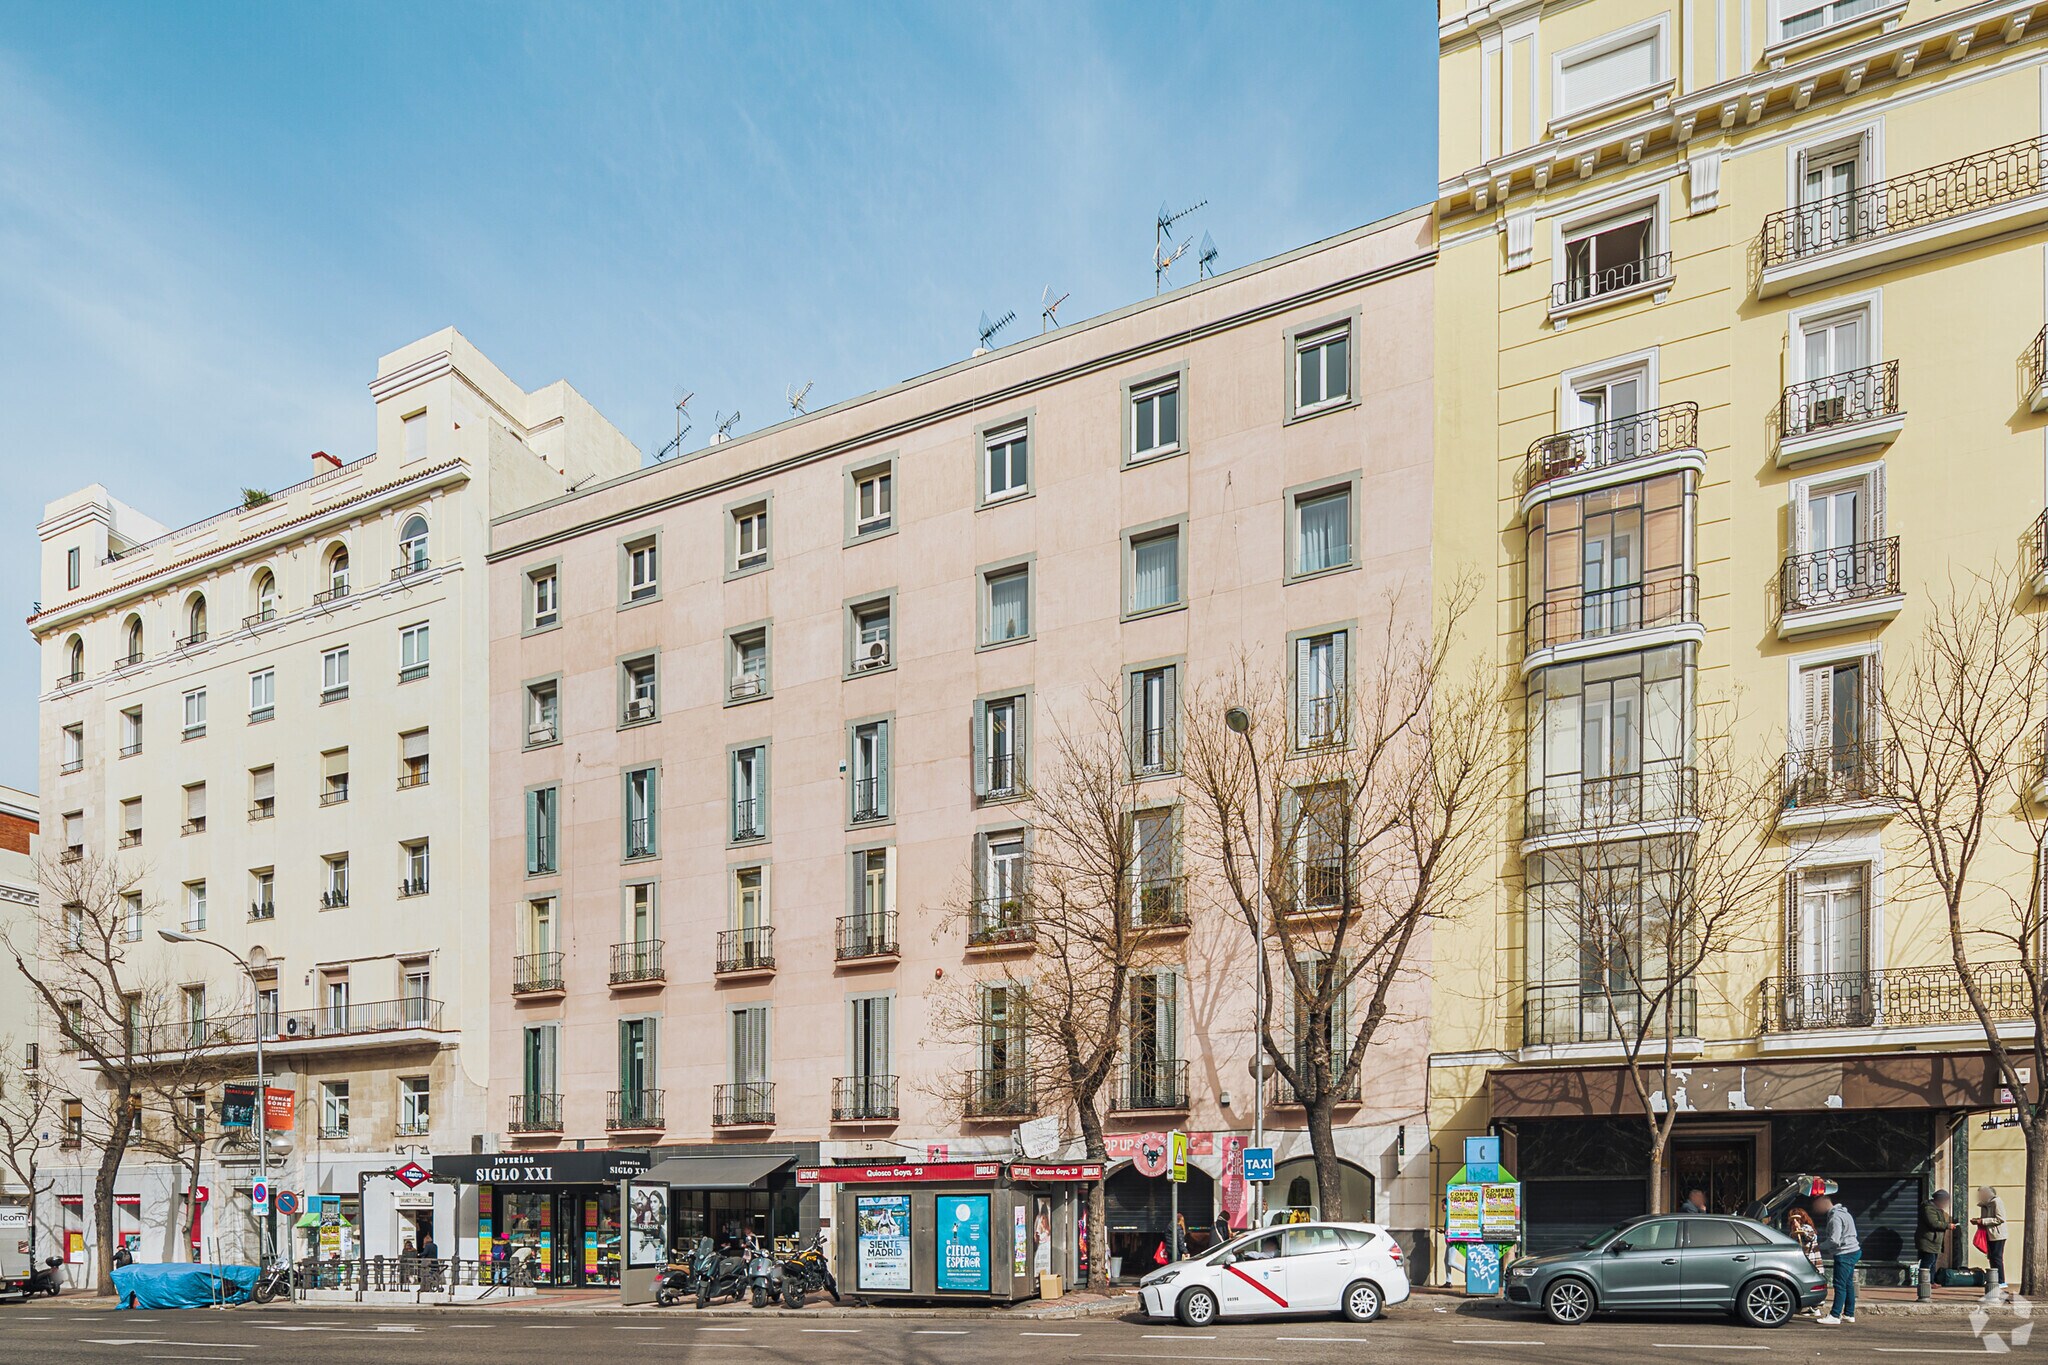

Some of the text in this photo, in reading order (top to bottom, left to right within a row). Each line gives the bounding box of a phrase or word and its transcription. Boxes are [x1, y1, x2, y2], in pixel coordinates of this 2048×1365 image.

[1103, 1139, 1118, 1151] OP
[1120, 1139, 1134, 1151] UP
[495, 1155, 534, 1165] JOYERÍAS
[1245, 1158, 1272, 1170] TAXI
[406, 1170, 423, 1179] Metro
[476, 1166, 553, 1181] SIGLO XXI
[609, 1166, 633, 1174] SIGLO
[866, 1168, 923, 1178] Quiosco Goya, 23
[1055, 1168, 1070, 1176] Goya,
[869, 1240, 900, 1249] SIENTE
[867, 1248, 903, 1257] MADRID
[946, 1244, 971, 1256] CIELO
